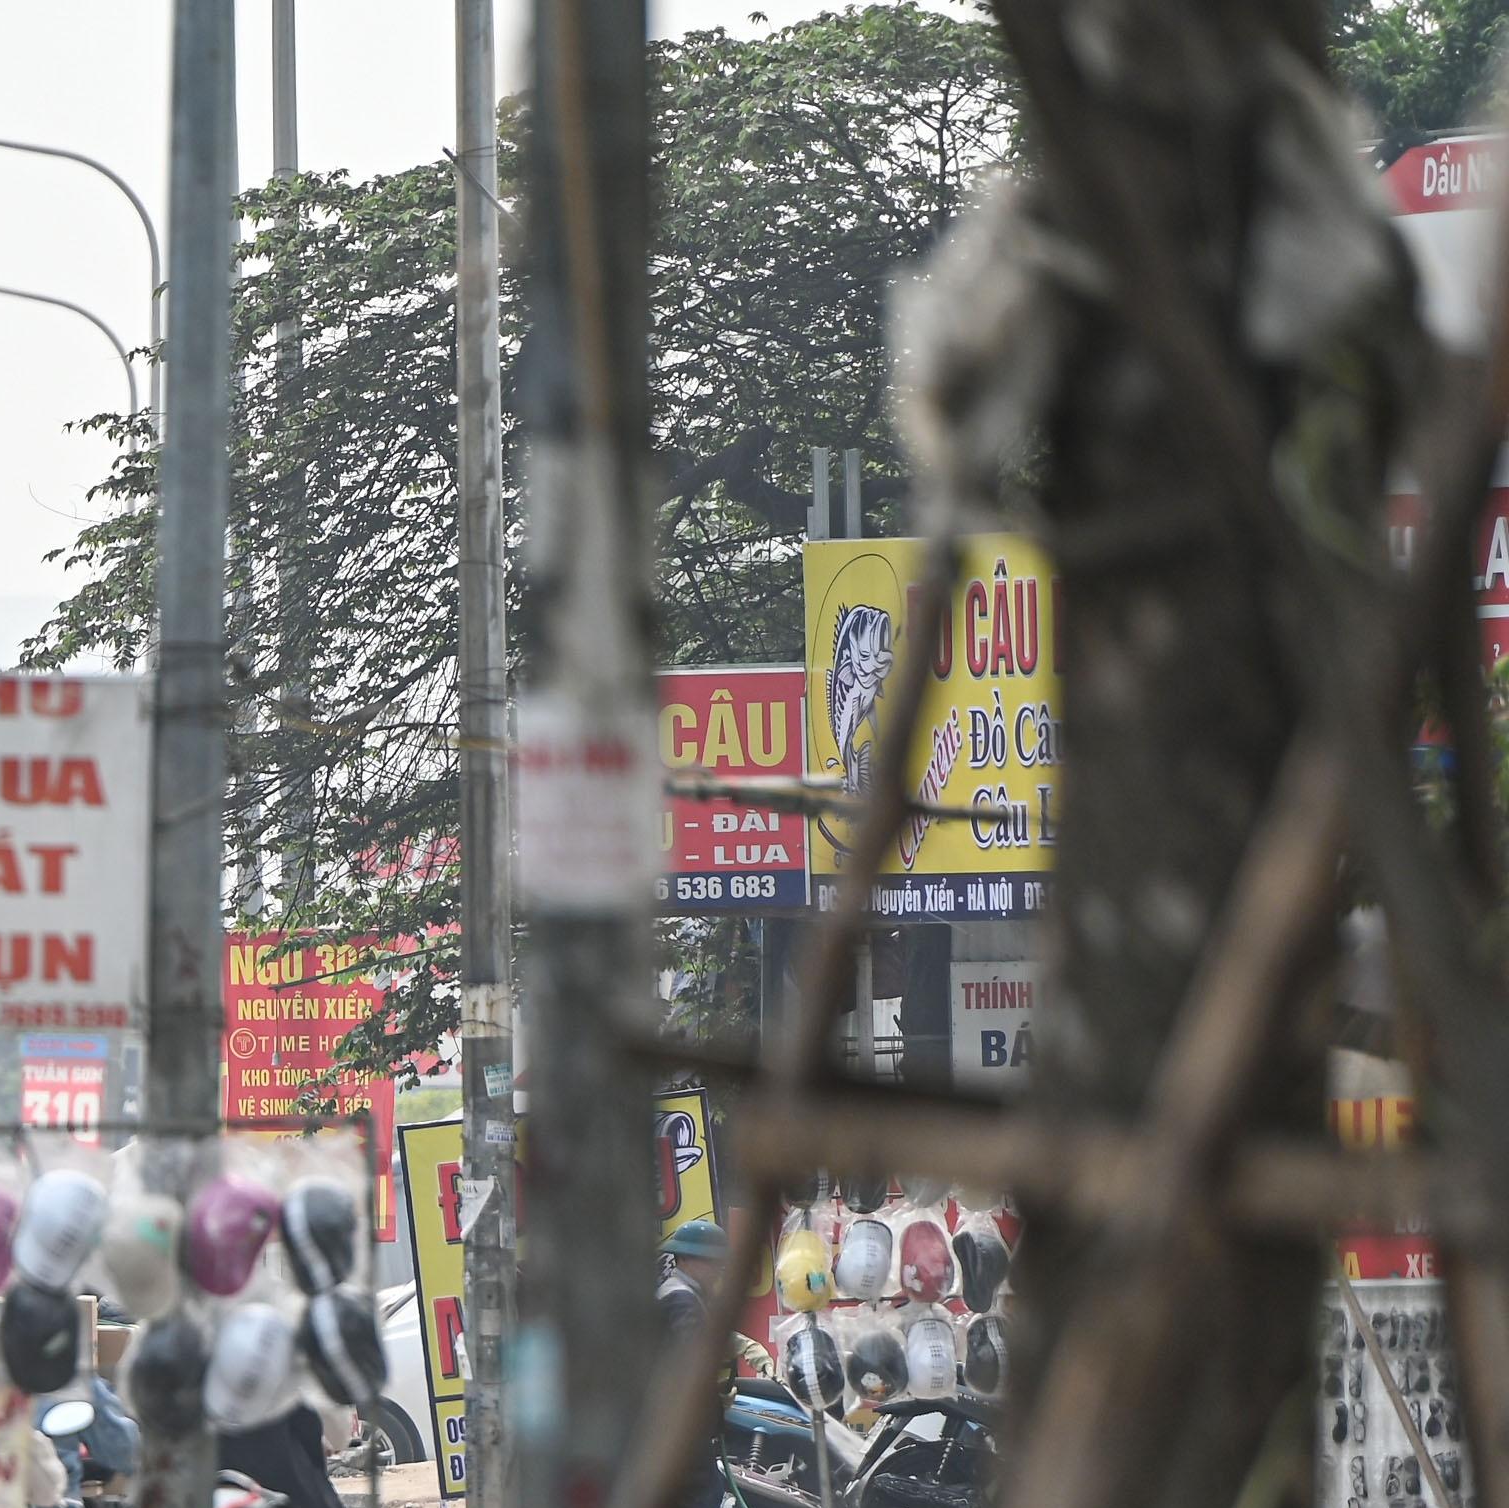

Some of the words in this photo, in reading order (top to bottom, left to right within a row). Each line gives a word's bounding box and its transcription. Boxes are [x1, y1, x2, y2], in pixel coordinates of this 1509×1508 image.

[1423, 145, 1461, 197] Dầu
[965, 558, 1039, 681] CÂU
[658, 689, 787, 768] CÂU
[969, 690, 1006, 768] Đồ
[712, 809, 780, 833] ĐÀI
[677, 876, 723, 900] 536
[731, 875, 776, 899] 683
[924, 877, 955, 912] Xiển
[968, 877, 985, 912] HÀ
[989, 876, 1013, 917] NỘI
[238, 991, 319, 1020] NGUYỄN
[324, 989, 373, 1020] XIỂN
[961, 975, 1033, 1010] THÍNH
[258, 1035, 310, 1053] TIME
[241, 1069, 270, 1087] KHO
[238, 1096, 256, 1119] VỆ
